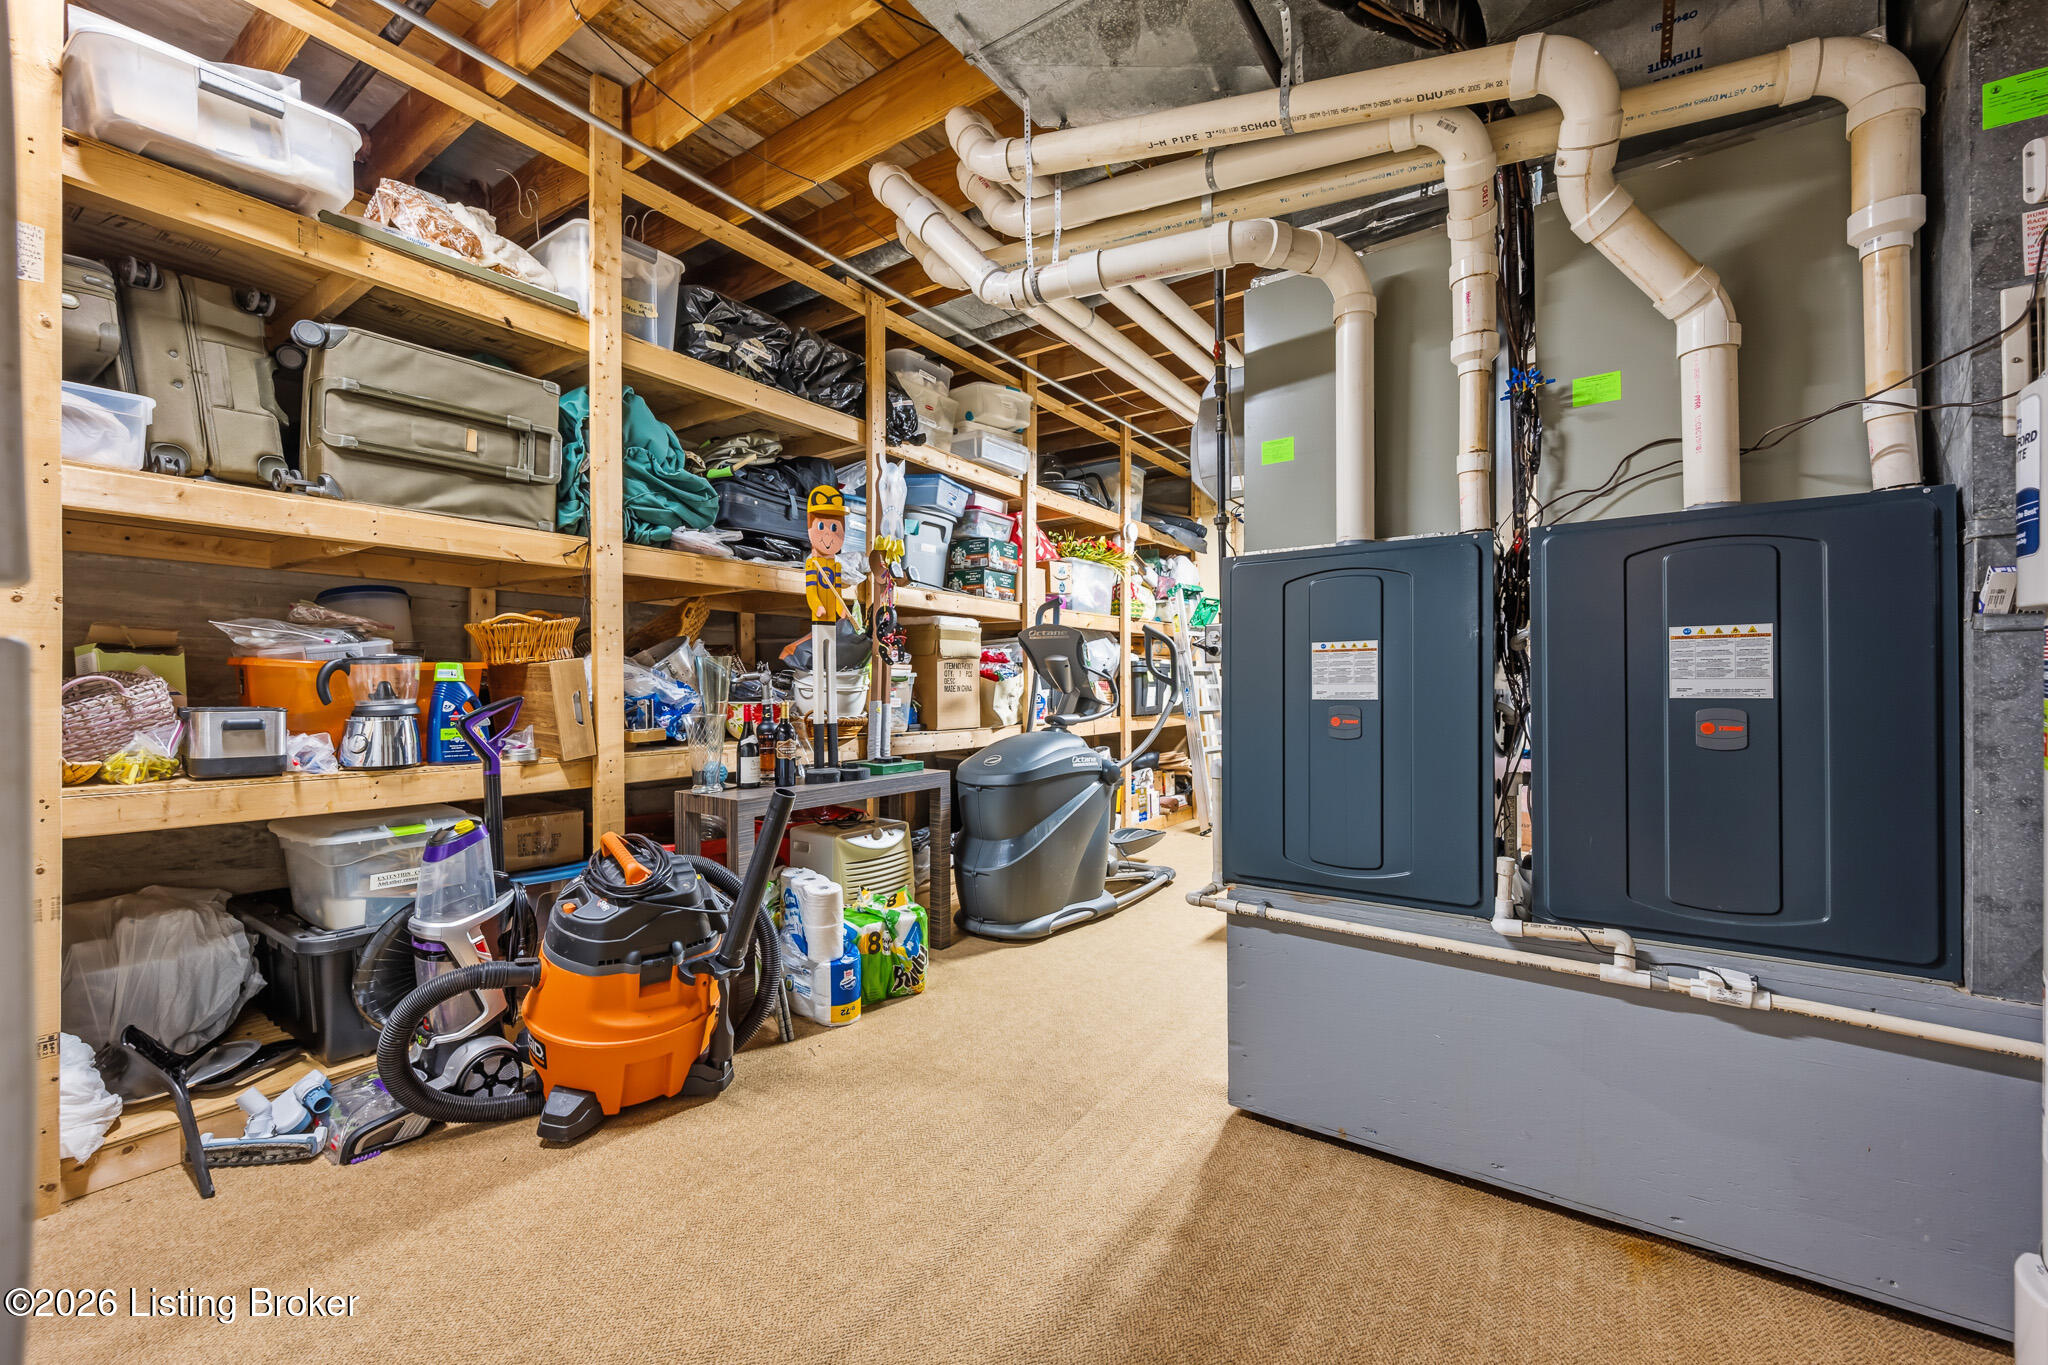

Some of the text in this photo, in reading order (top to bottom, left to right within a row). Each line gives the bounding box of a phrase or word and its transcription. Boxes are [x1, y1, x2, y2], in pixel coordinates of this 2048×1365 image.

[1172, 133, 1199, 145] PIPE
[1240, 119, 1277, 133] SCH40
[1416, 90, 1443, 103] DWV
[1072, 755, 1097, 763] Octane
[886, 893, 898, 908] 8
[868, 931, 882, 954] 8
